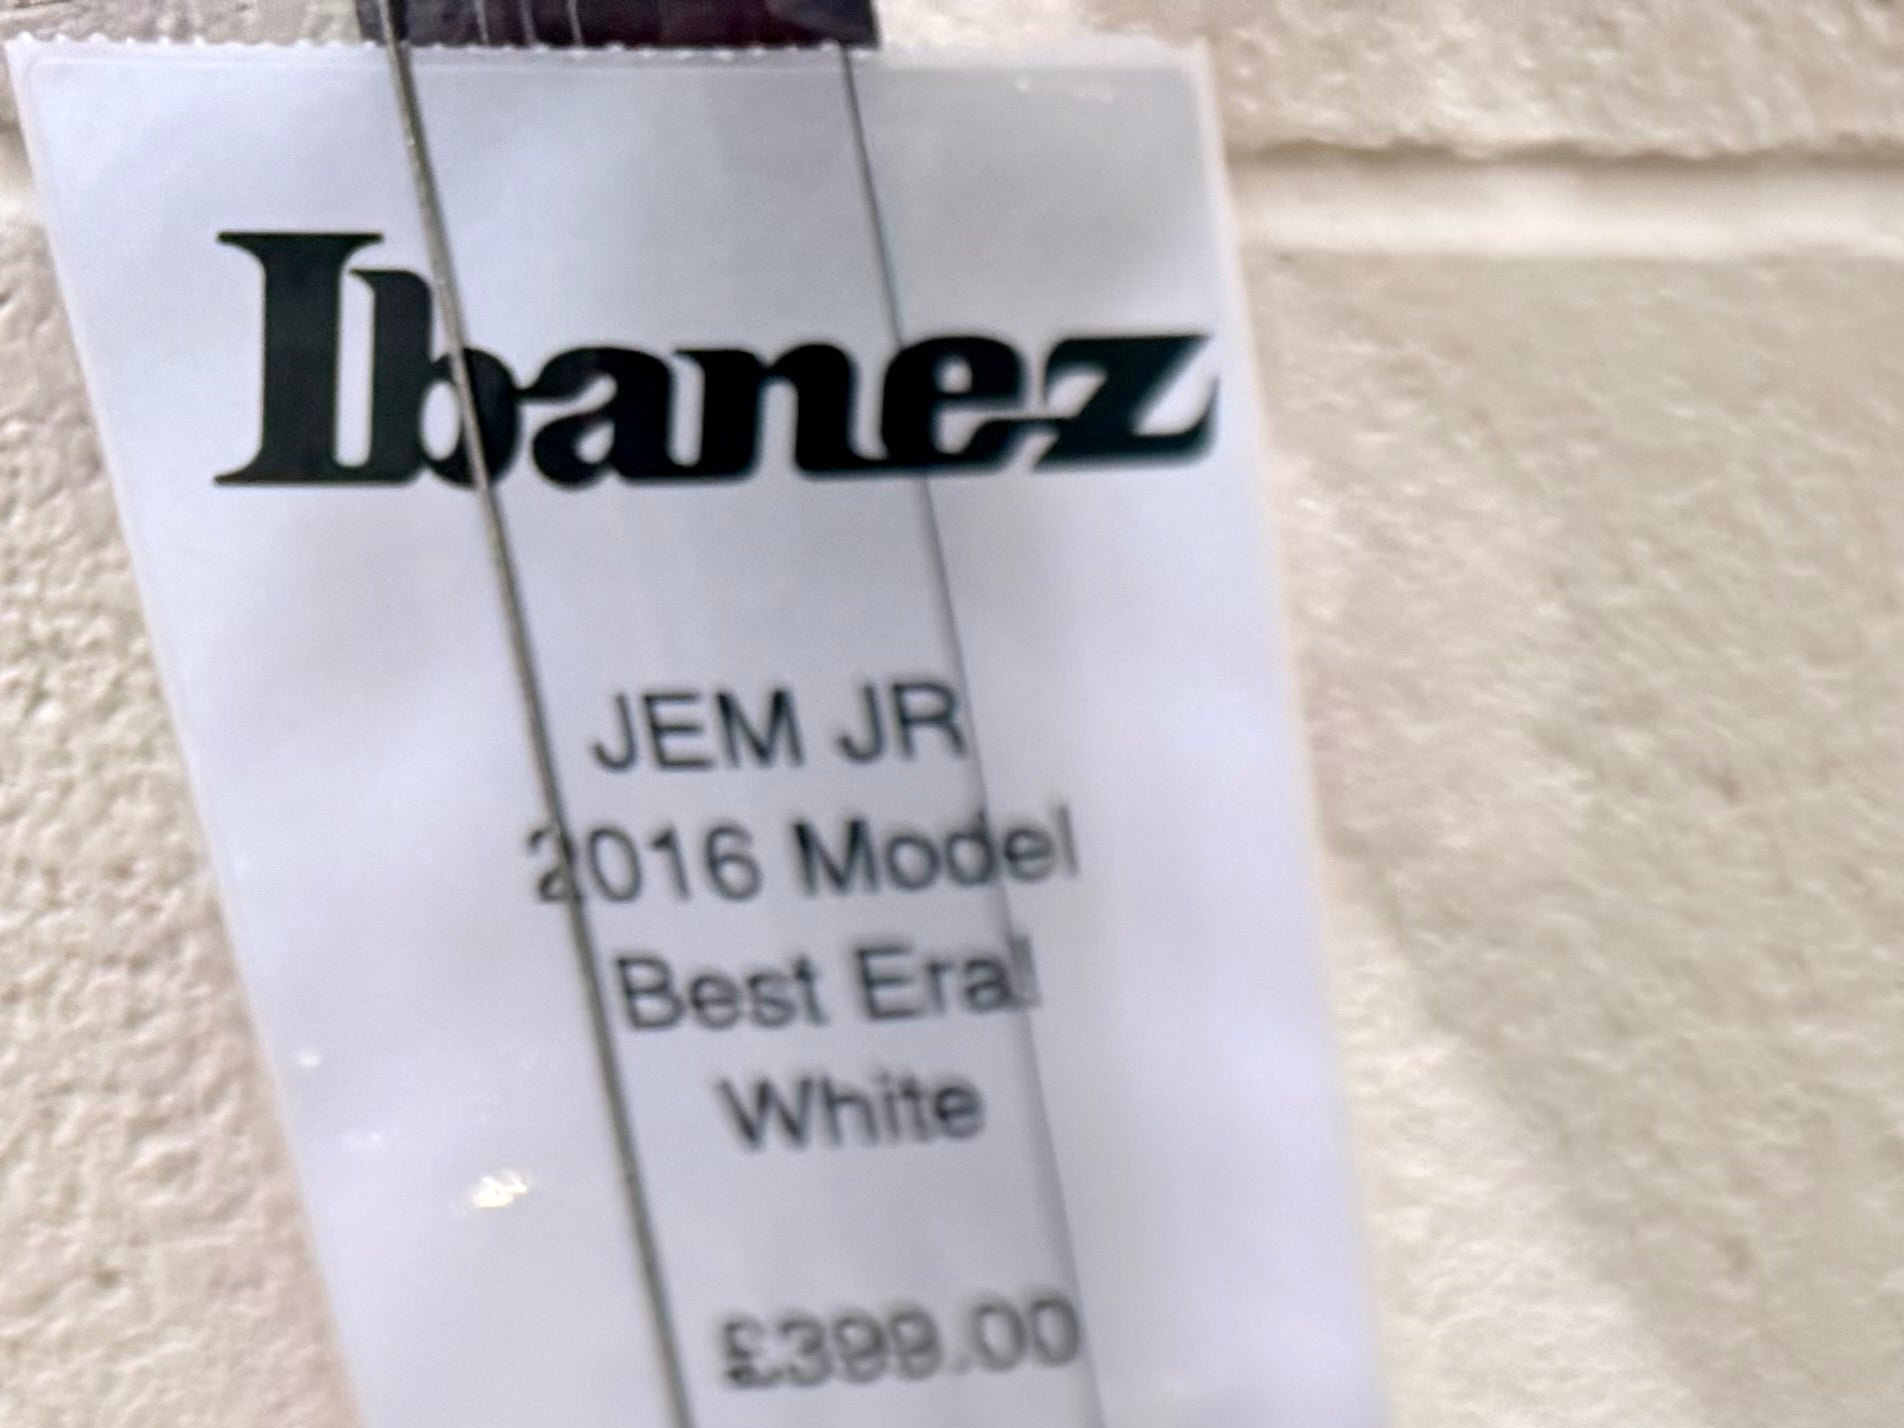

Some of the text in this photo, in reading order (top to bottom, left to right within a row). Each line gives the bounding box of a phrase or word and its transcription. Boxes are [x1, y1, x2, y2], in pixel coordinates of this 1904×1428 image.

[213, 231, 1219, 490] Ibanez
[592, 680, 967, 772] JEM JR
[526, 806, 1079, 905] 2016 Model
[614, 954, 830, 1031] Best
[716, 1072, 985, 1150] White
[720, 1292, 1080, 1389] £399.00
